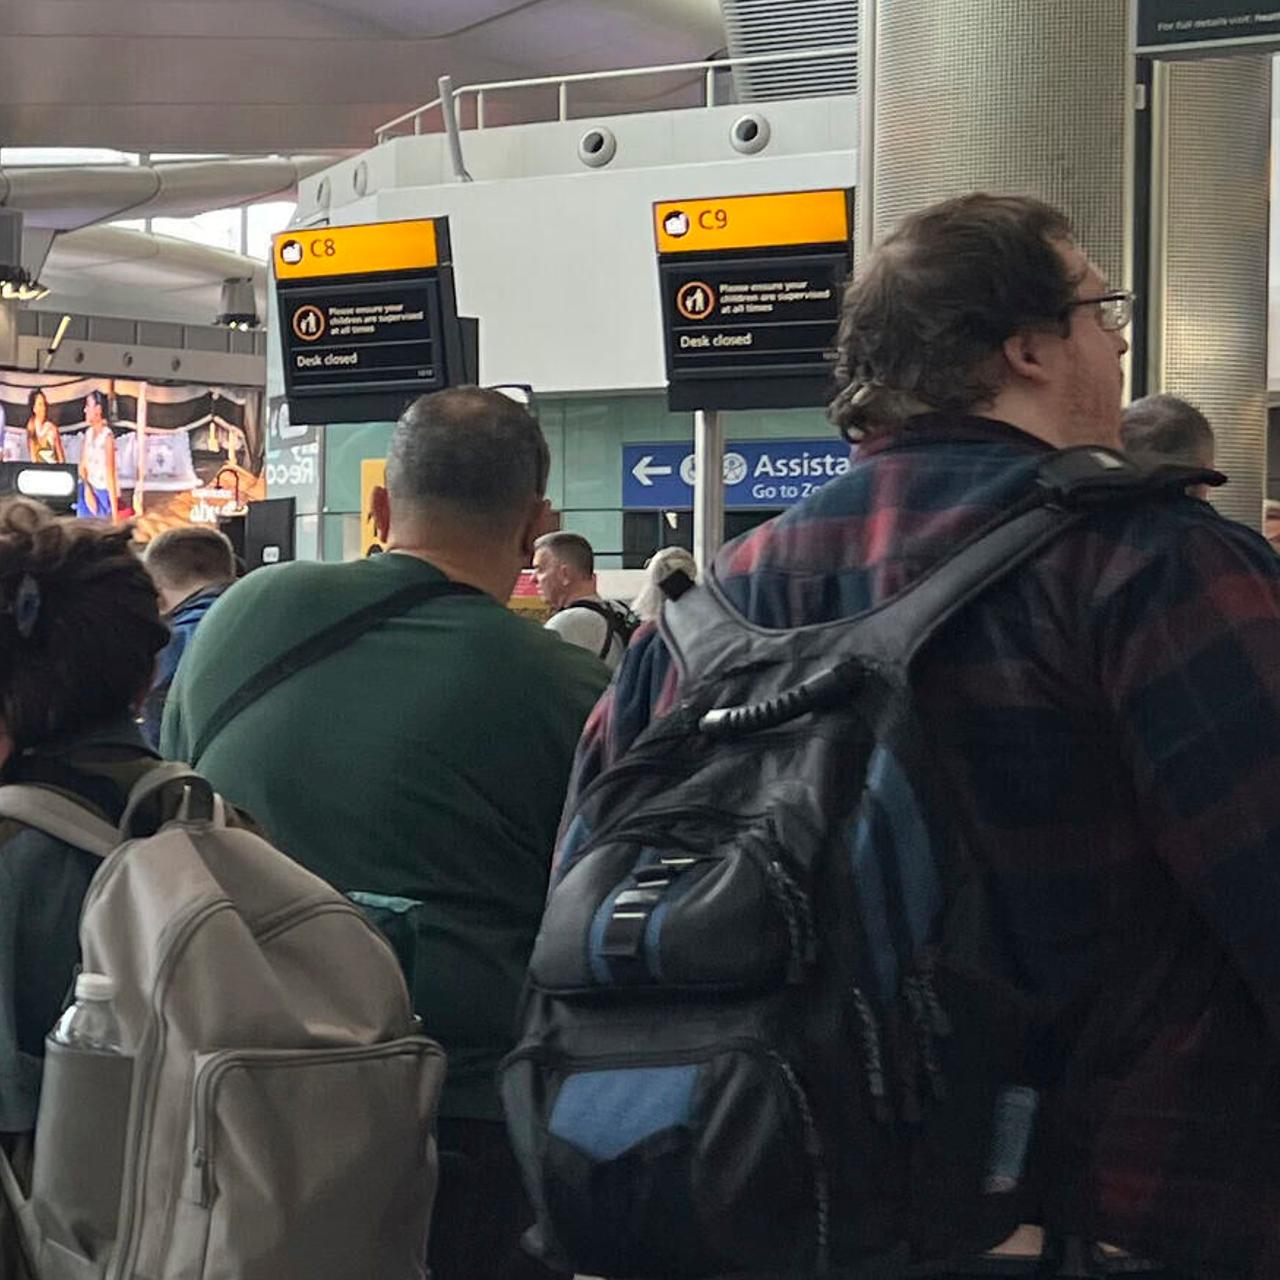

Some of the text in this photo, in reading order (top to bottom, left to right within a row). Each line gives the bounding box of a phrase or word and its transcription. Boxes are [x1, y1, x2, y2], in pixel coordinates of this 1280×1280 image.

[698, 208, 728, 230] C9
[310, 237, 336, 257] C8
[680, 333, 752, 348] Desk closed
[296, 352, 358, 368] Desk closed
[753, 451, 851, 477] Assista
[752, 484, 776, 499] Go
[780, 484, 798, 498] to
